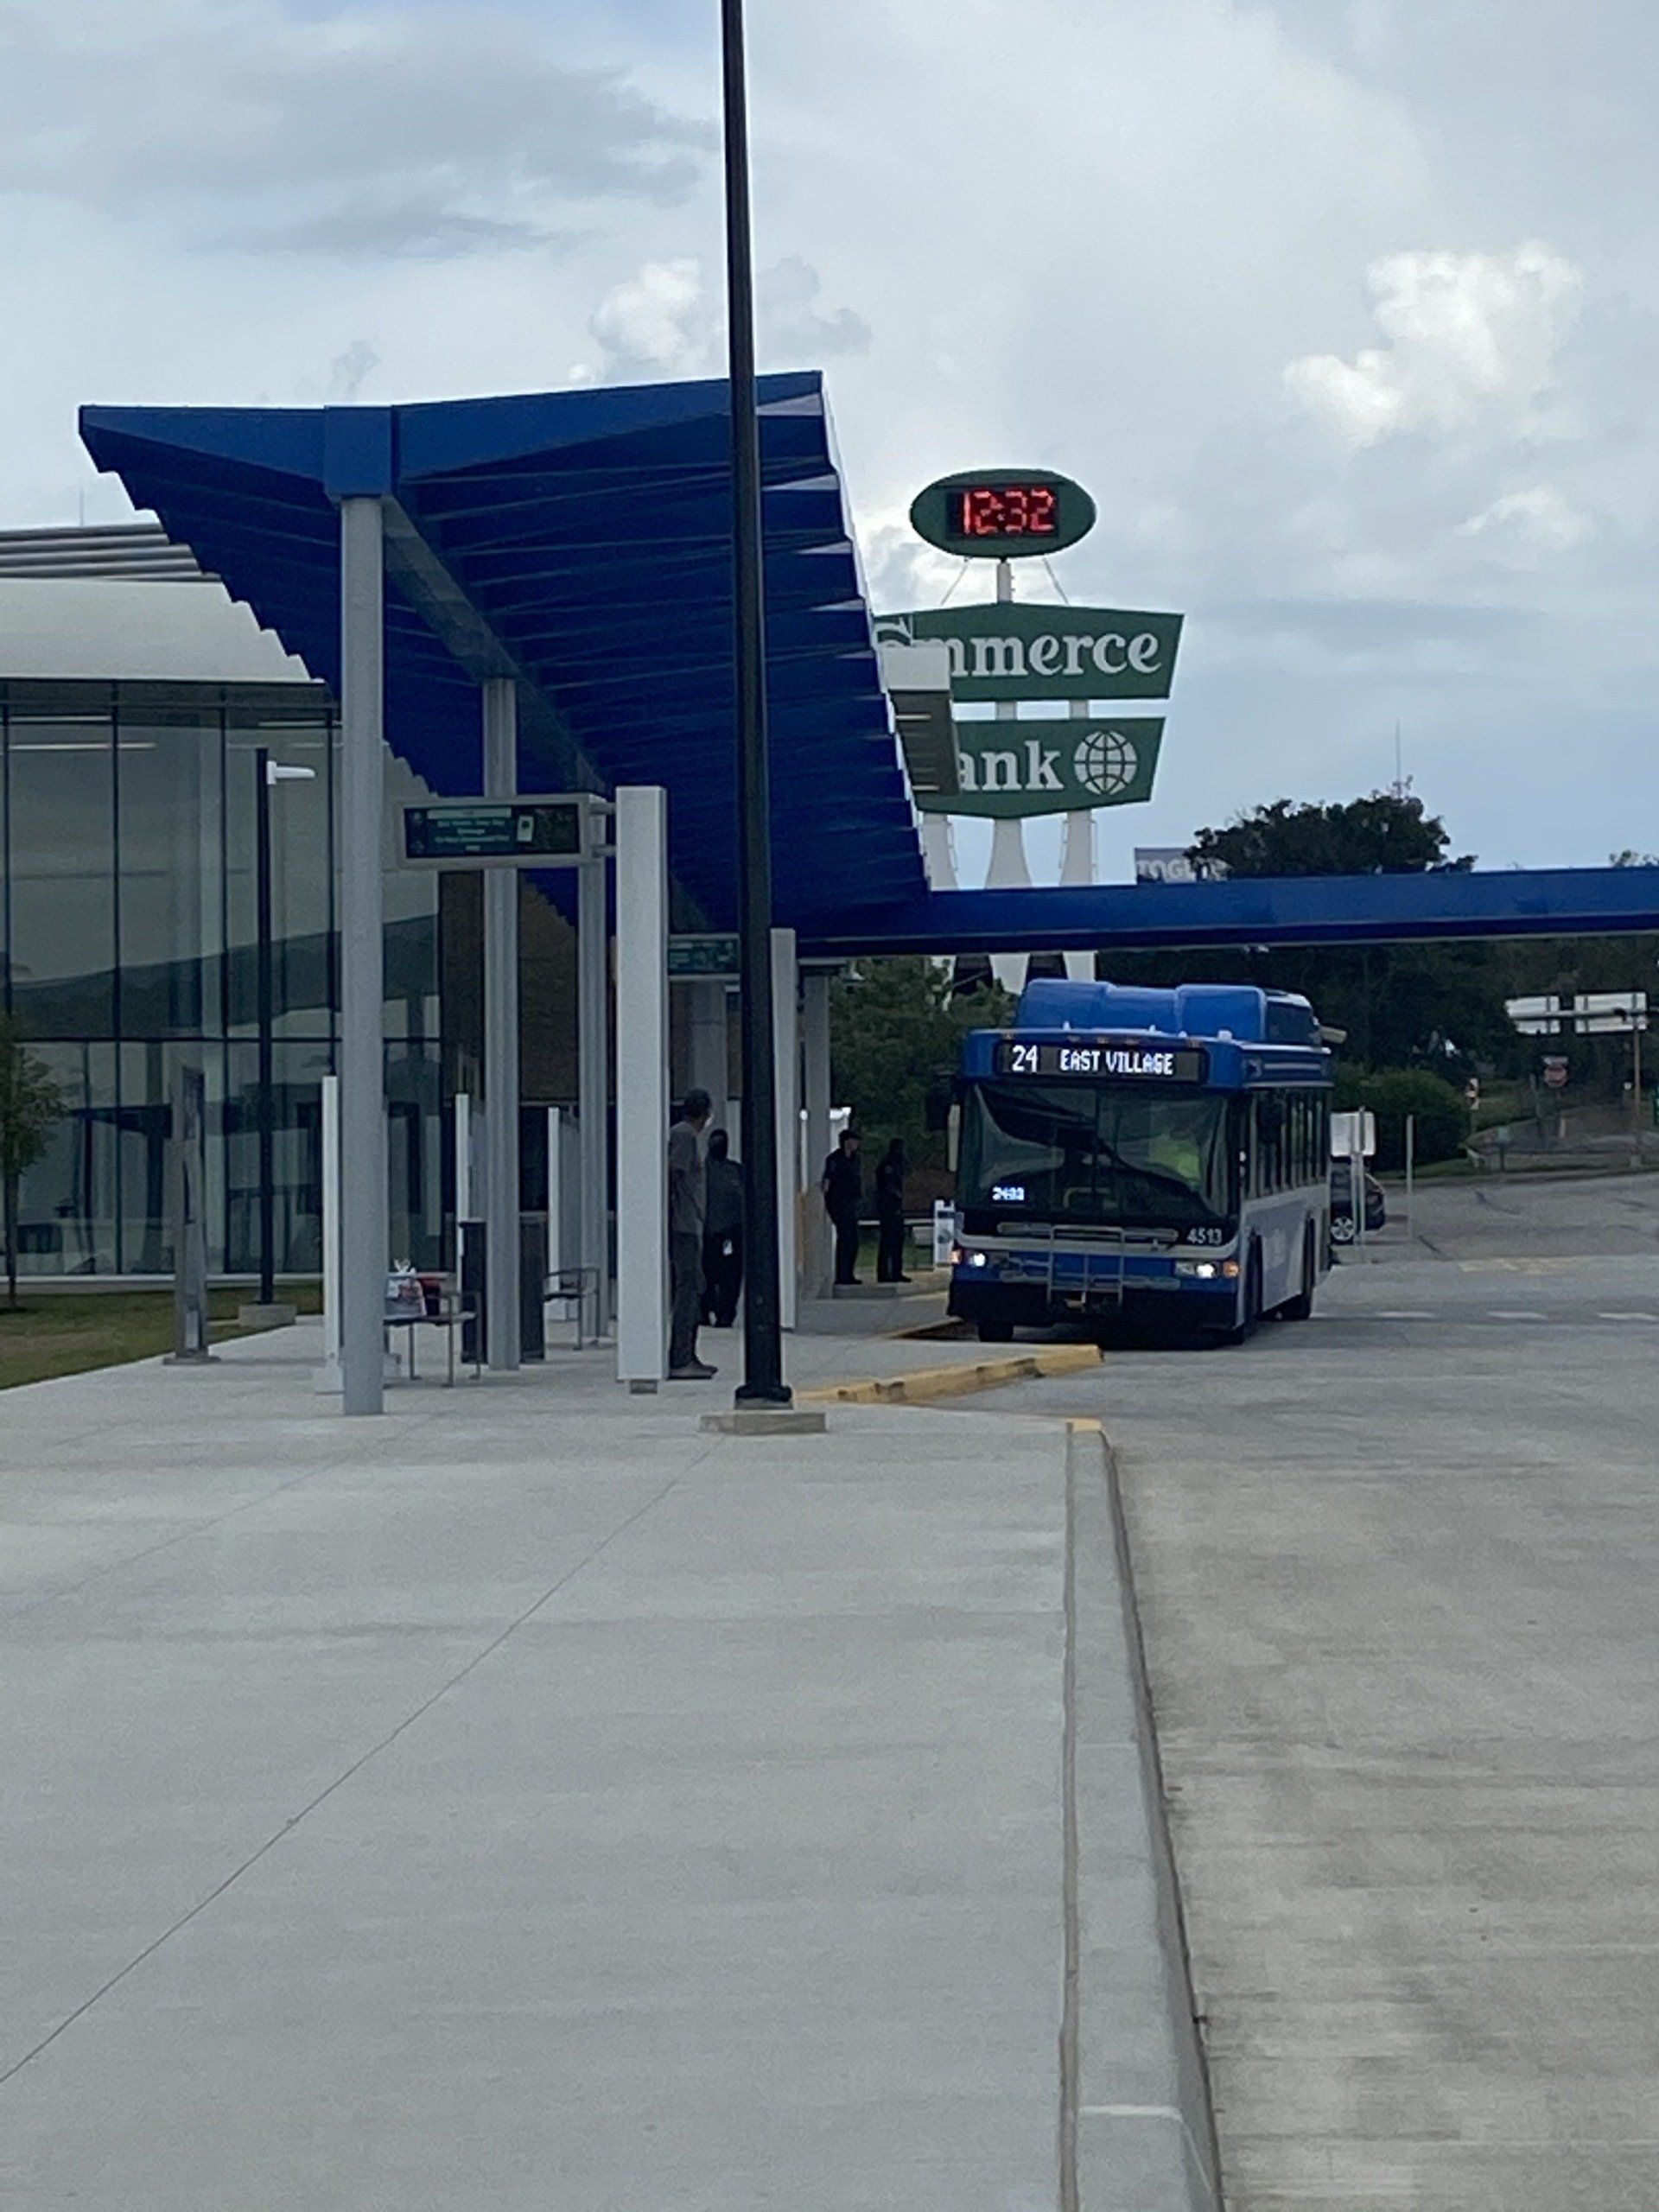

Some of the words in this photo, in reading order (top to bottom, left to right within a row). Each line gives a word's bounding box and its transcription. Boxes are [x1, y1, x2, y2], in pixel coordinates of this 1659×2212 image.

[963, 489, 1055, 534] 12:32
[957, 741, 1065, 791] ank
[1012, 1045, 1038, 1072] 24
[1060, 1048, 1101, 1071] EAST
[1106, 1051, 1173, 1075] VILLAGE
